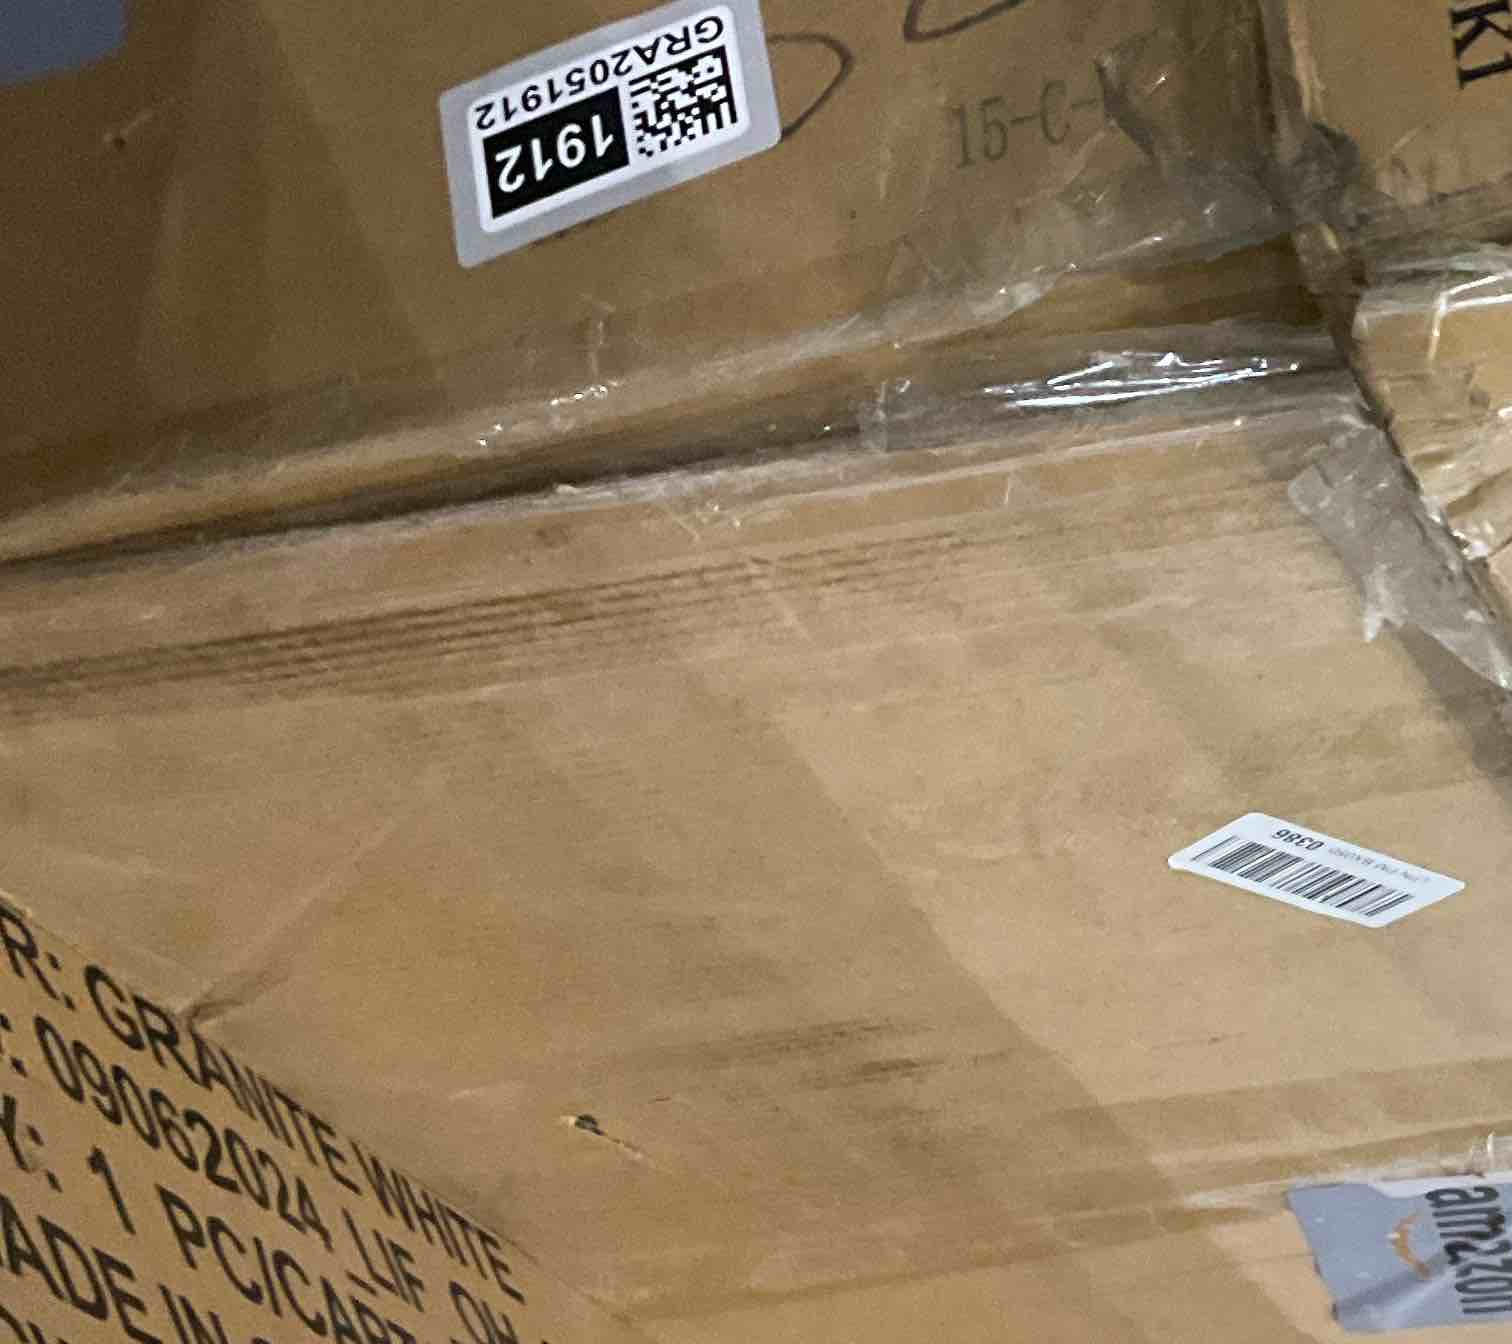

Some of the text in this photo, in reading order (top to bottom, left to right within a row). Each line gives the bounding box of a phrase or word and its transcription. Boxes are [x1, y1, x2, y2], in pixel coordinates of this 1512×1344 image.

[475, 15, 724, 131] GRA2051912
[494, 113, 615, 193] 1912
[945, 76, 1100, 170] 15-C-
[1270, 827, 1326, 852] 0386
[83, 963, 363, 1197] GRANITE
[351, 1140, 526, 1306] WHITE
[86, 1145, 137, 1236] 1
